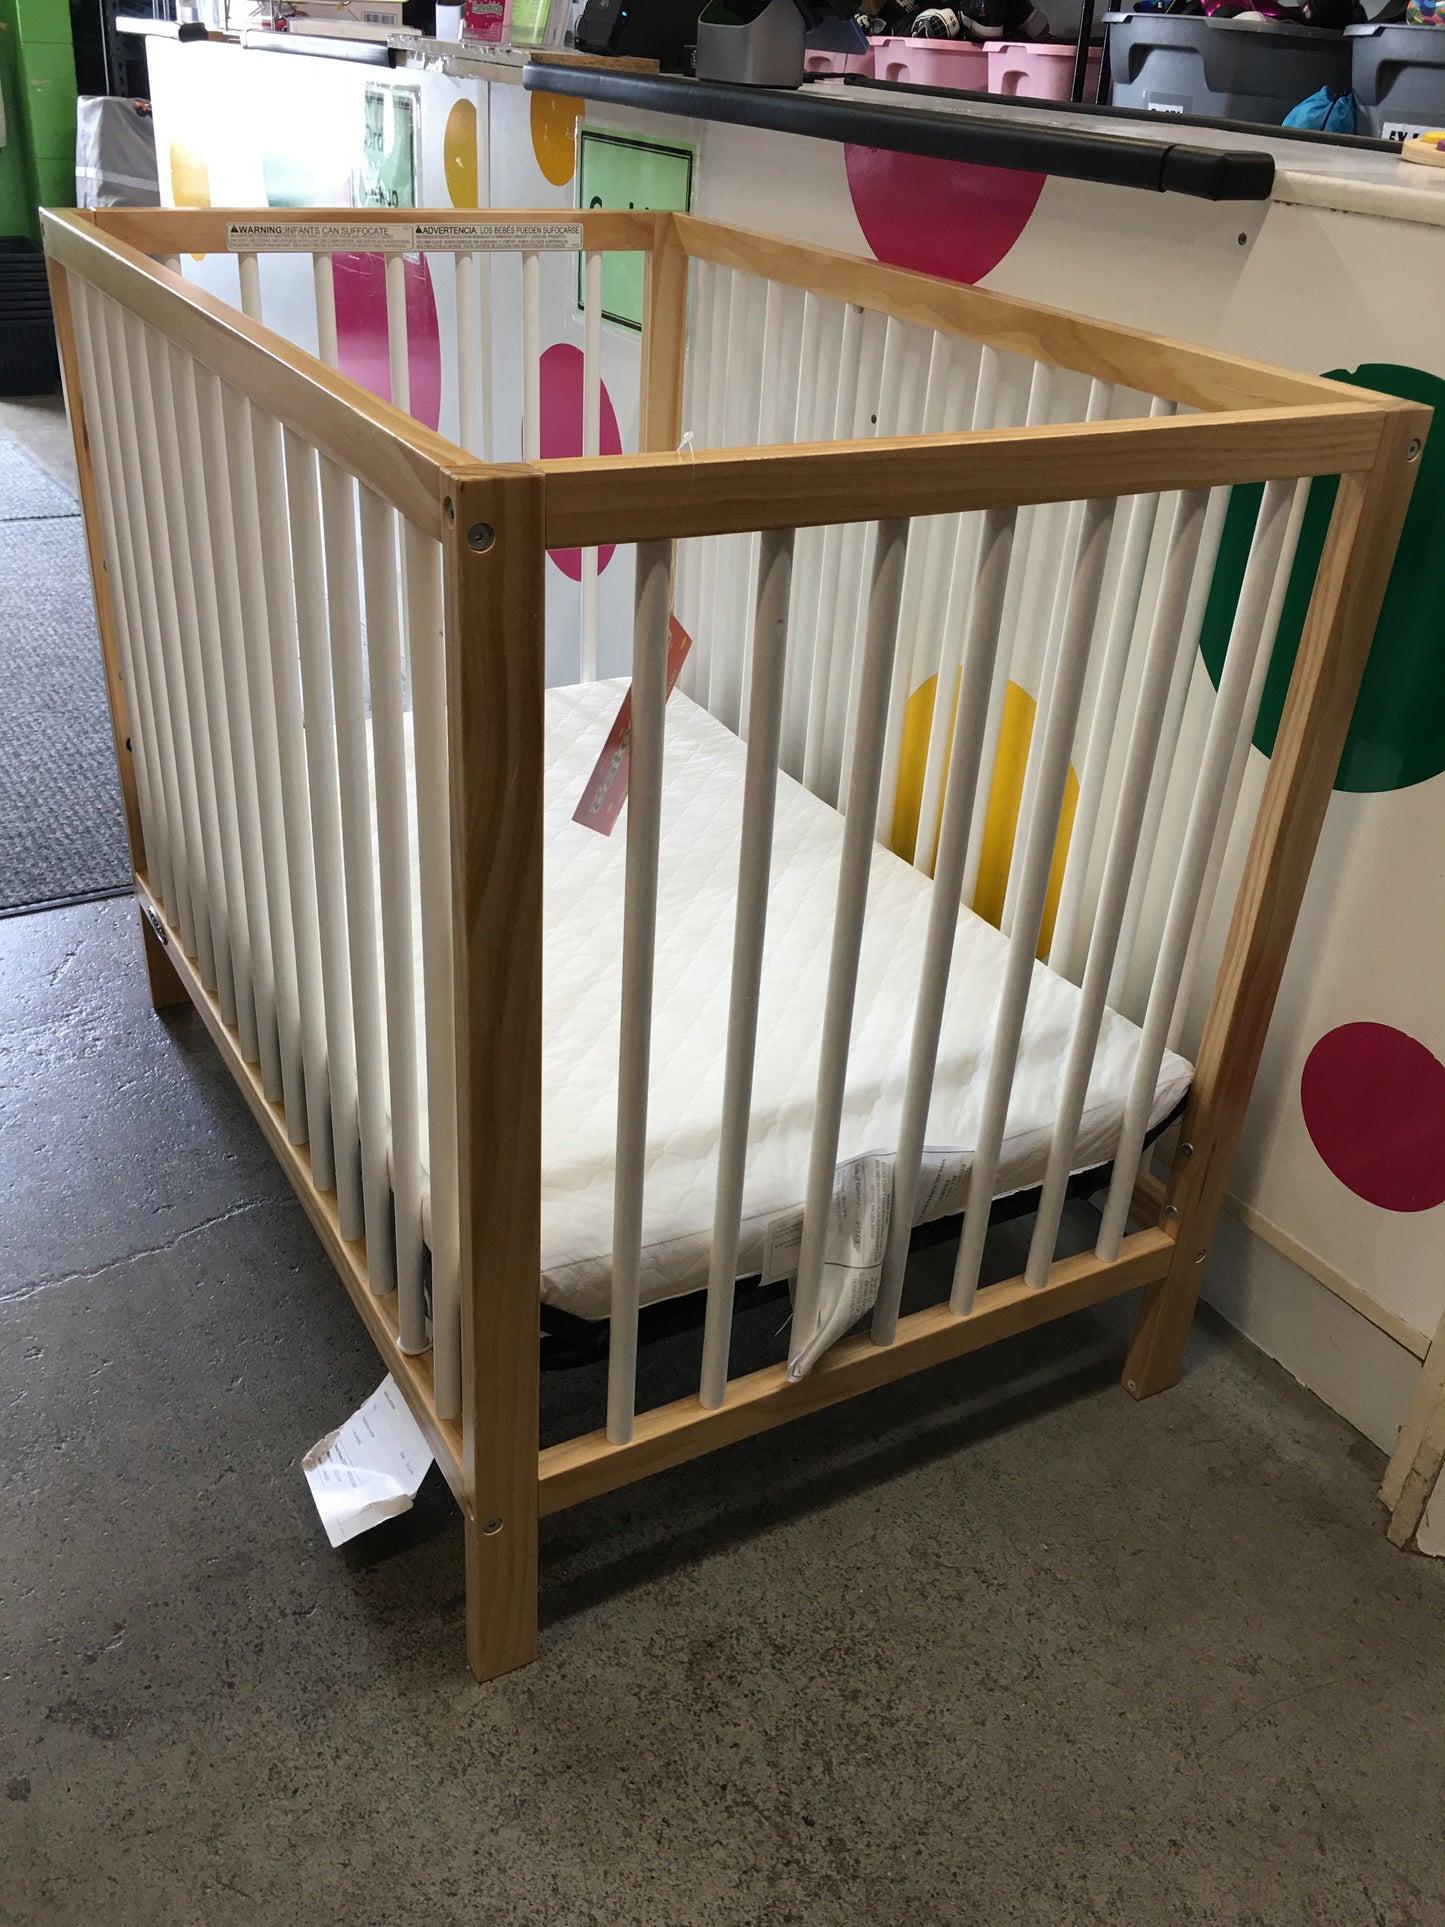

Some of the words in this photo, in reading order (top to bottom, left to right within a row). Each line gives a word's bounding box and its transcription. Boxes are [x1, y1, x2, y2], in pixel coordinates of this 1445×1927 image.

[285, 226, 320, 235] INFANTS
[322, 226, 339, 235] CAN
[341, 227, 389, 236] SUFFOCATE
[480, 226, 494, 235] LOS
[516, 226, 541, 235] PUEDEN
[543, 226, 580, 235] SUFOCARSE
